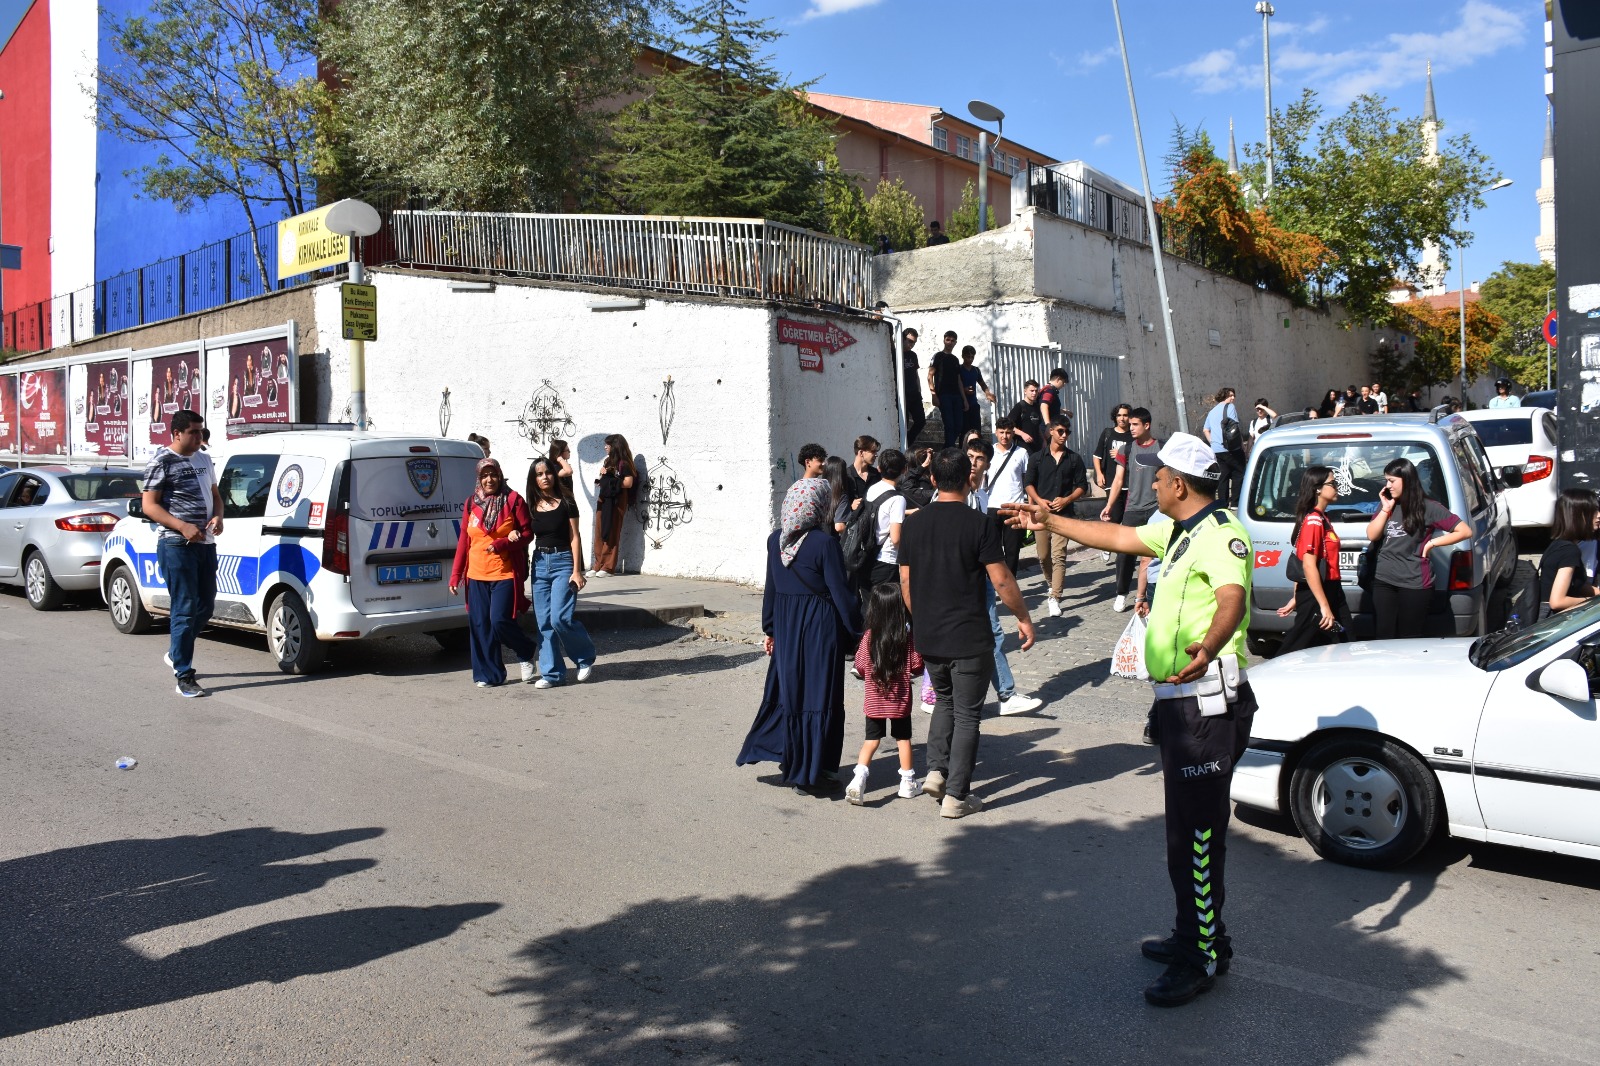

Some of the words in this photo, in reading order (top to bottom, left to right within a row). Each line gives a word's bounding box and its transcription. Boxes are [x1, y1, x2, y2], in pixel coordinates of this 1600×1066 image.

[298, 238, 327, 266] KIRIKKALE
[344, 297, 354, 305] Park
[782, 324, 824, 343] ÖĞRETMEN
[800, 347, 814, 355] HOTEL
[311, 504, 322, 517] 112
[371, 505, 410, 517] TOPLUM
[1340, 552, 1354, 565] BN
[385, 568, 397, 580] 71
[405, 567, 411, 579] A
[418, 565, 440, 578] 6594
